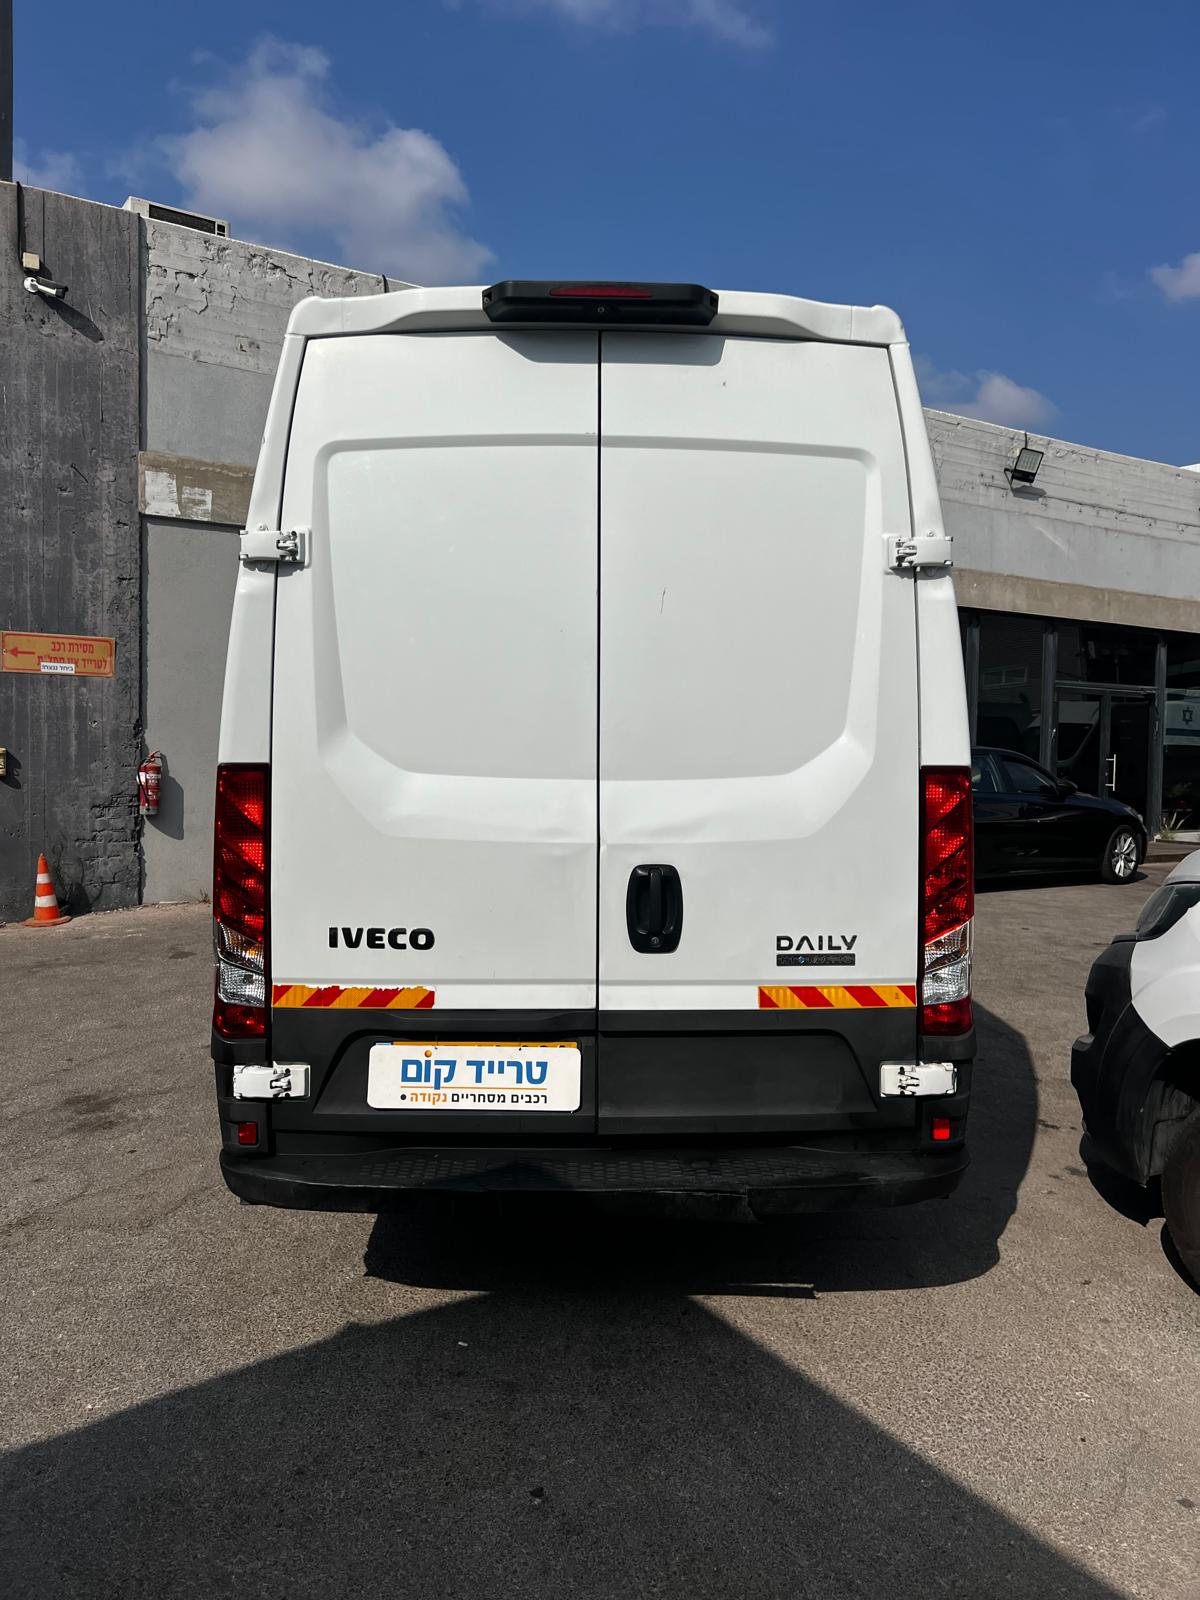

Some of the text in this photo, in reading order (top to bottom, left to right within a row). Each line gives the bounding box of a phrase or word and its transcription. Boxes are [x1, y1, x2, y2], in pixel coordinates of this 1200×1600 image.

[51, 641, 94, 654] מסירת רכב
[82, 657, 107, 669] לטרייד
[328, 927, 435, 950] IVECO
[776, 935, 858, 951] DAILY
[466, 1060, 548, 1085] טרייד
[410, 1092, 548, 1105] רכבים מסחריים נקודה
